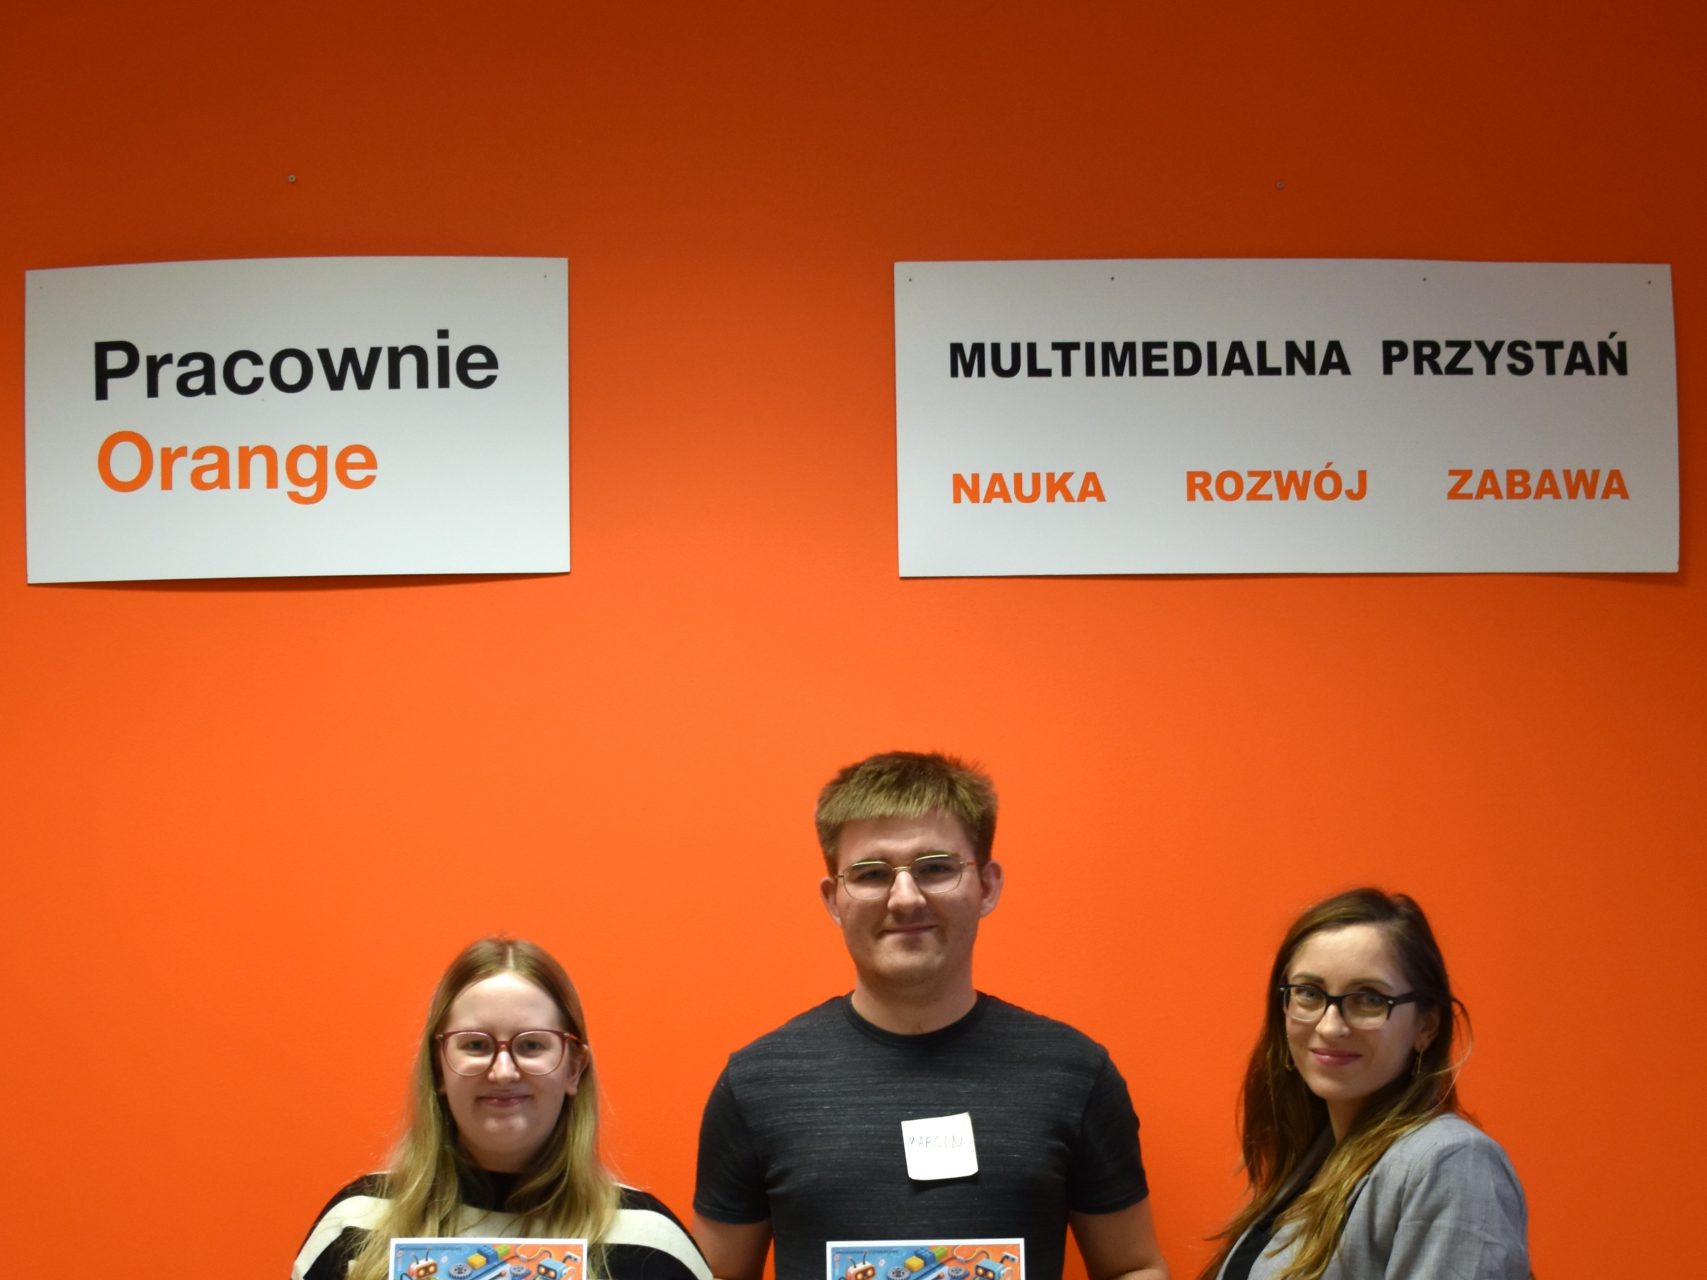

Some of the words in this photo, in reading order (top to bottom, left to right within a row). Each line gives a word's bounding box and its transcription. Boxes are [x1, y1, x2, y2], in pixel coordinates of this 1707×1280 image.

[94, 328, 499, 402] Pracownie
[949, 339, 1352, 378] MULTIMEDIALNA
[1381, 331, 1629, 377] PRZYSTAŃ
[97, 430, 378, 505] Orange
[952, 471, 1107, 504] NAUKA
[1185, 462, 1368, 502] ROZWÓJ
[1446, 468, 1630, 501] ZABAWA
